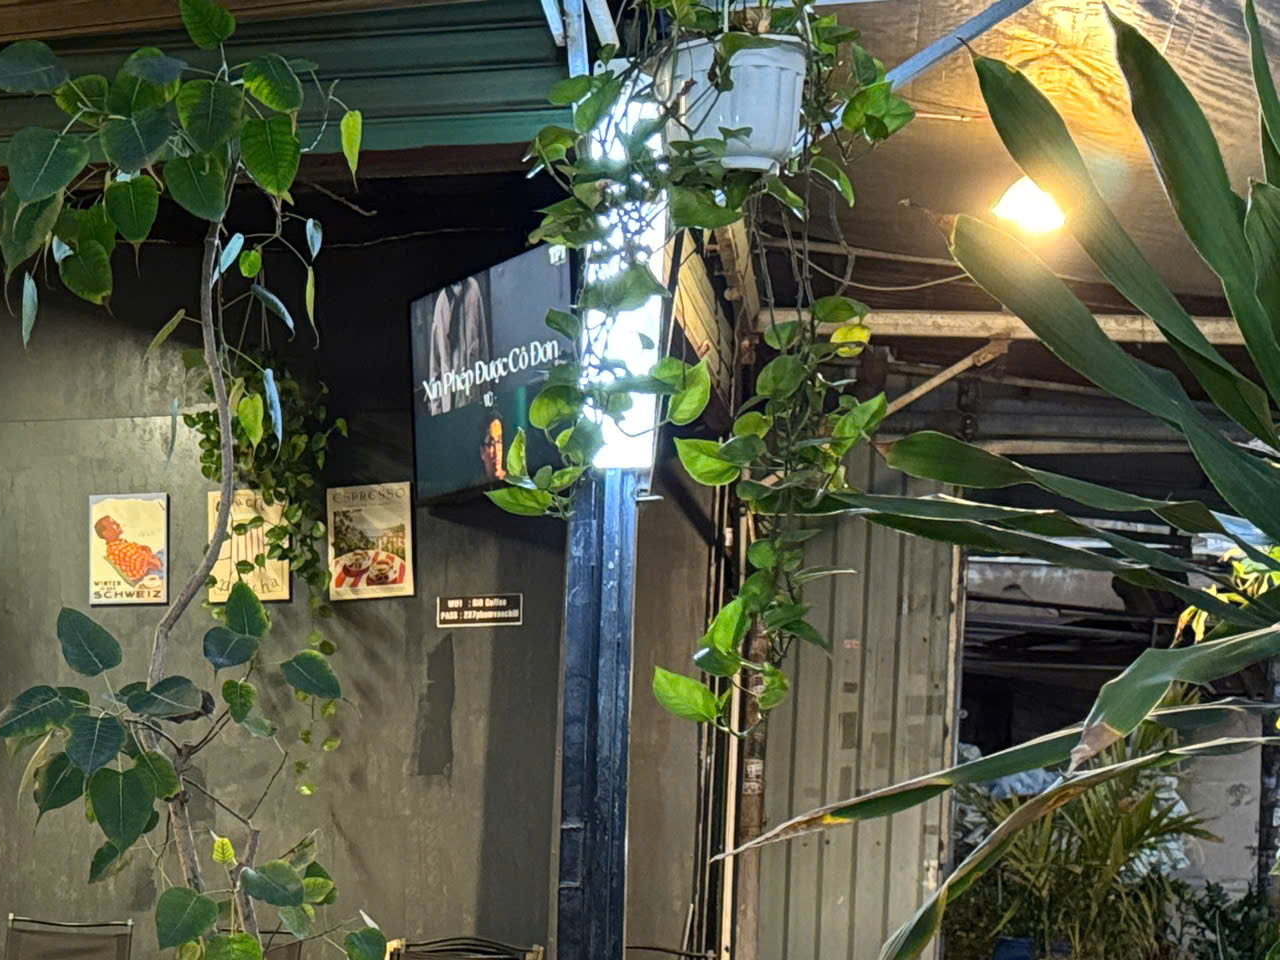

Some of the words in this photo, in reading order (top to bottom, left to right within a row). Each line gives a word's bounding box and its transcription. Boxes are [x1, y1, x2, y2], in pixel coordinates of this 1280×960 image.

[423, 378, 442, 402] Xin
[443, 366, 474, 396] Phép
[475, 357, 509, 384] Được
[94, 590, 161, 599] SCHWEIZ
[440, 611, 458, 620] PASS
